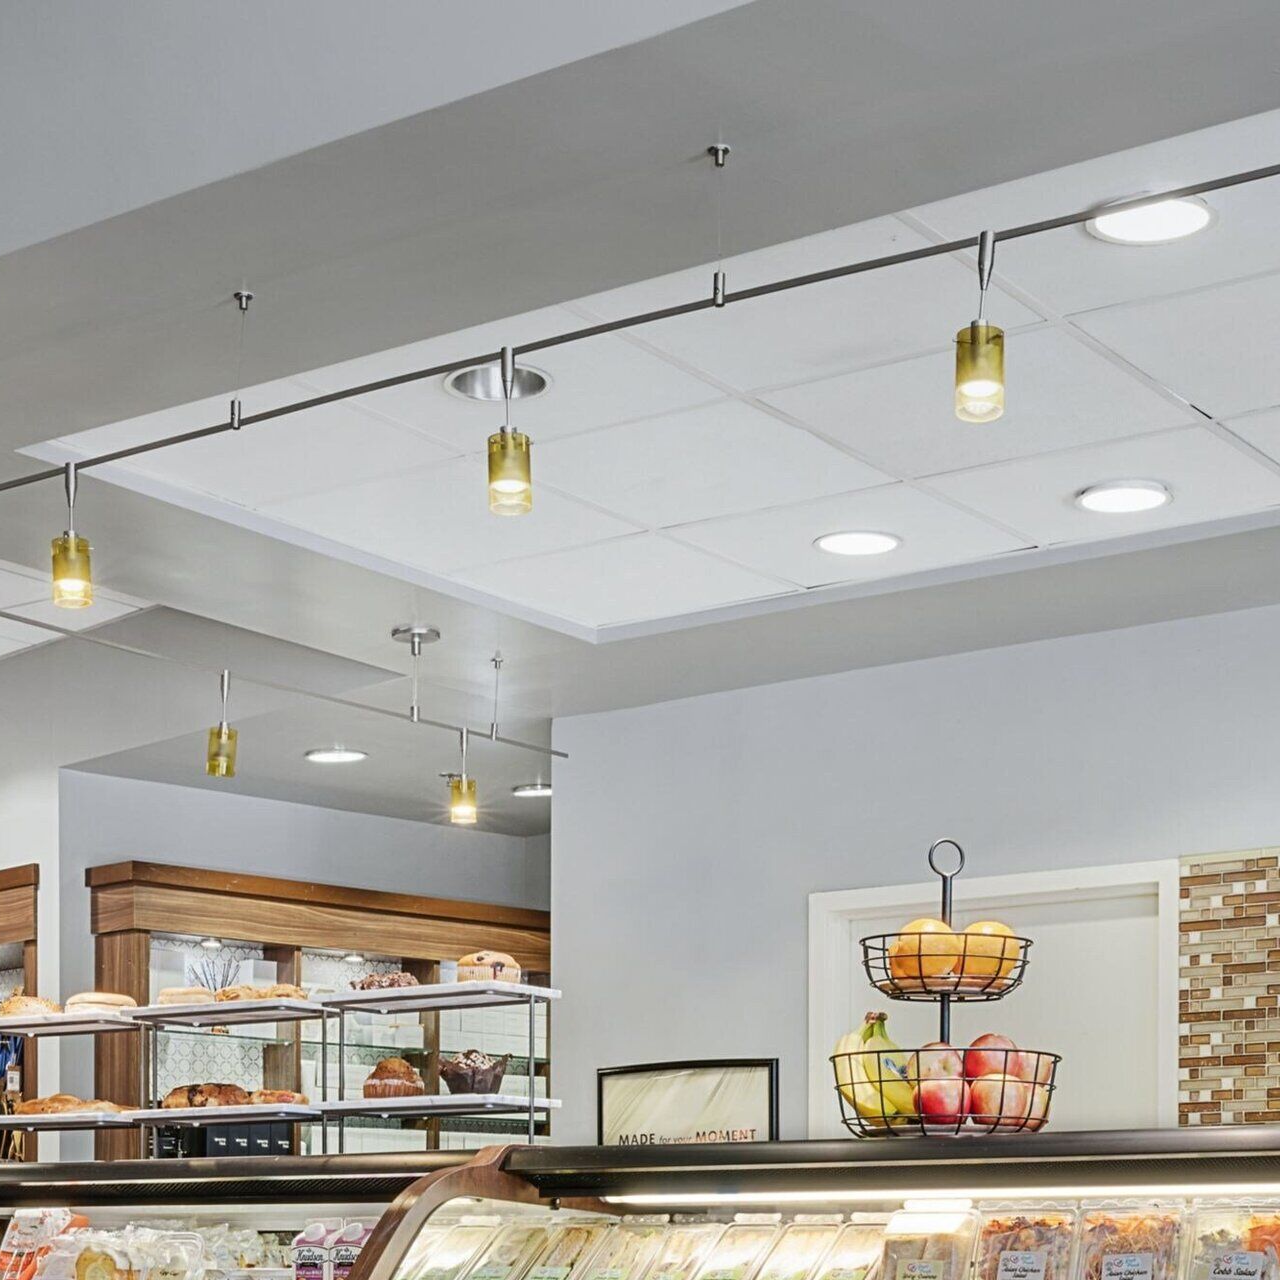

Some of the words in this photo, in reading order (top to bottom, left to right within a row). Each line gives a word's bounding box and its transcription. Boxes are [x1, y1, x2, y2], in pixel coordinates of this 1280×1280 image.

[620, 1134, 655, 1145] MADE
[659, 1135, 670, 1145] for
[696, 1129, 756, 1143] MOMENT
